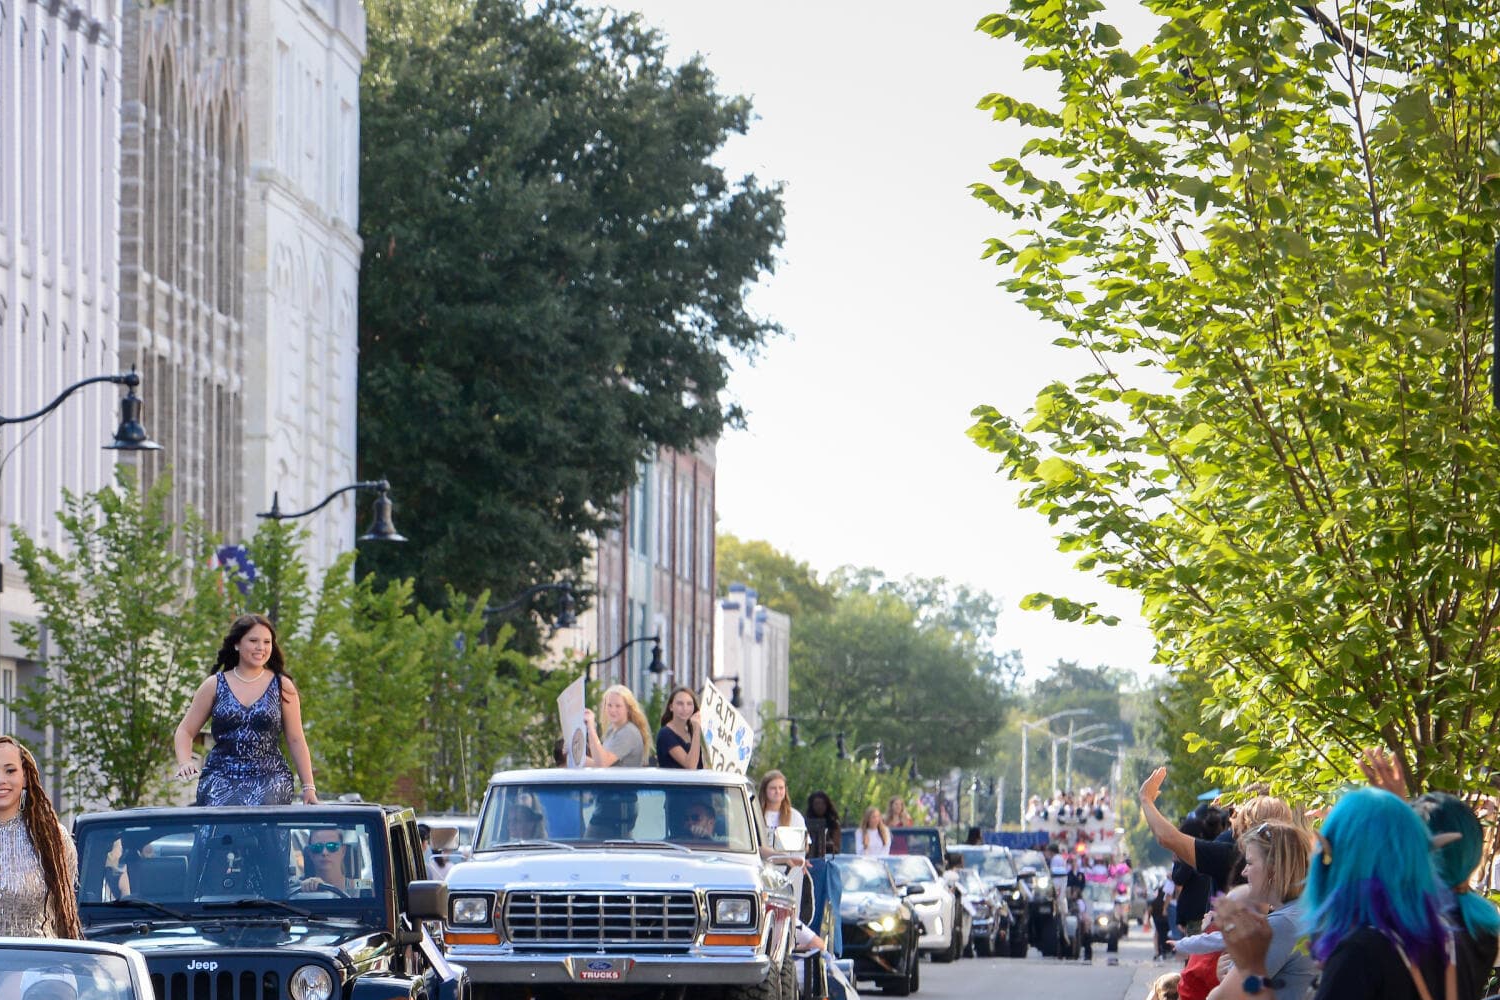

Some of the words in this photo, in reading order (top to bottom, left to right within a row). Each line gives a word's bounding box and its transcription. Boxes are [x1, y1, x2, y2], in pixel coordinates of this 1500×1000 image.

[706, 684, 736, 732] Jam
[717, 726, 733, 748] the
[187, 959, 218, 971] Jeep
[581, 970, 619, 979] TRUCKS
